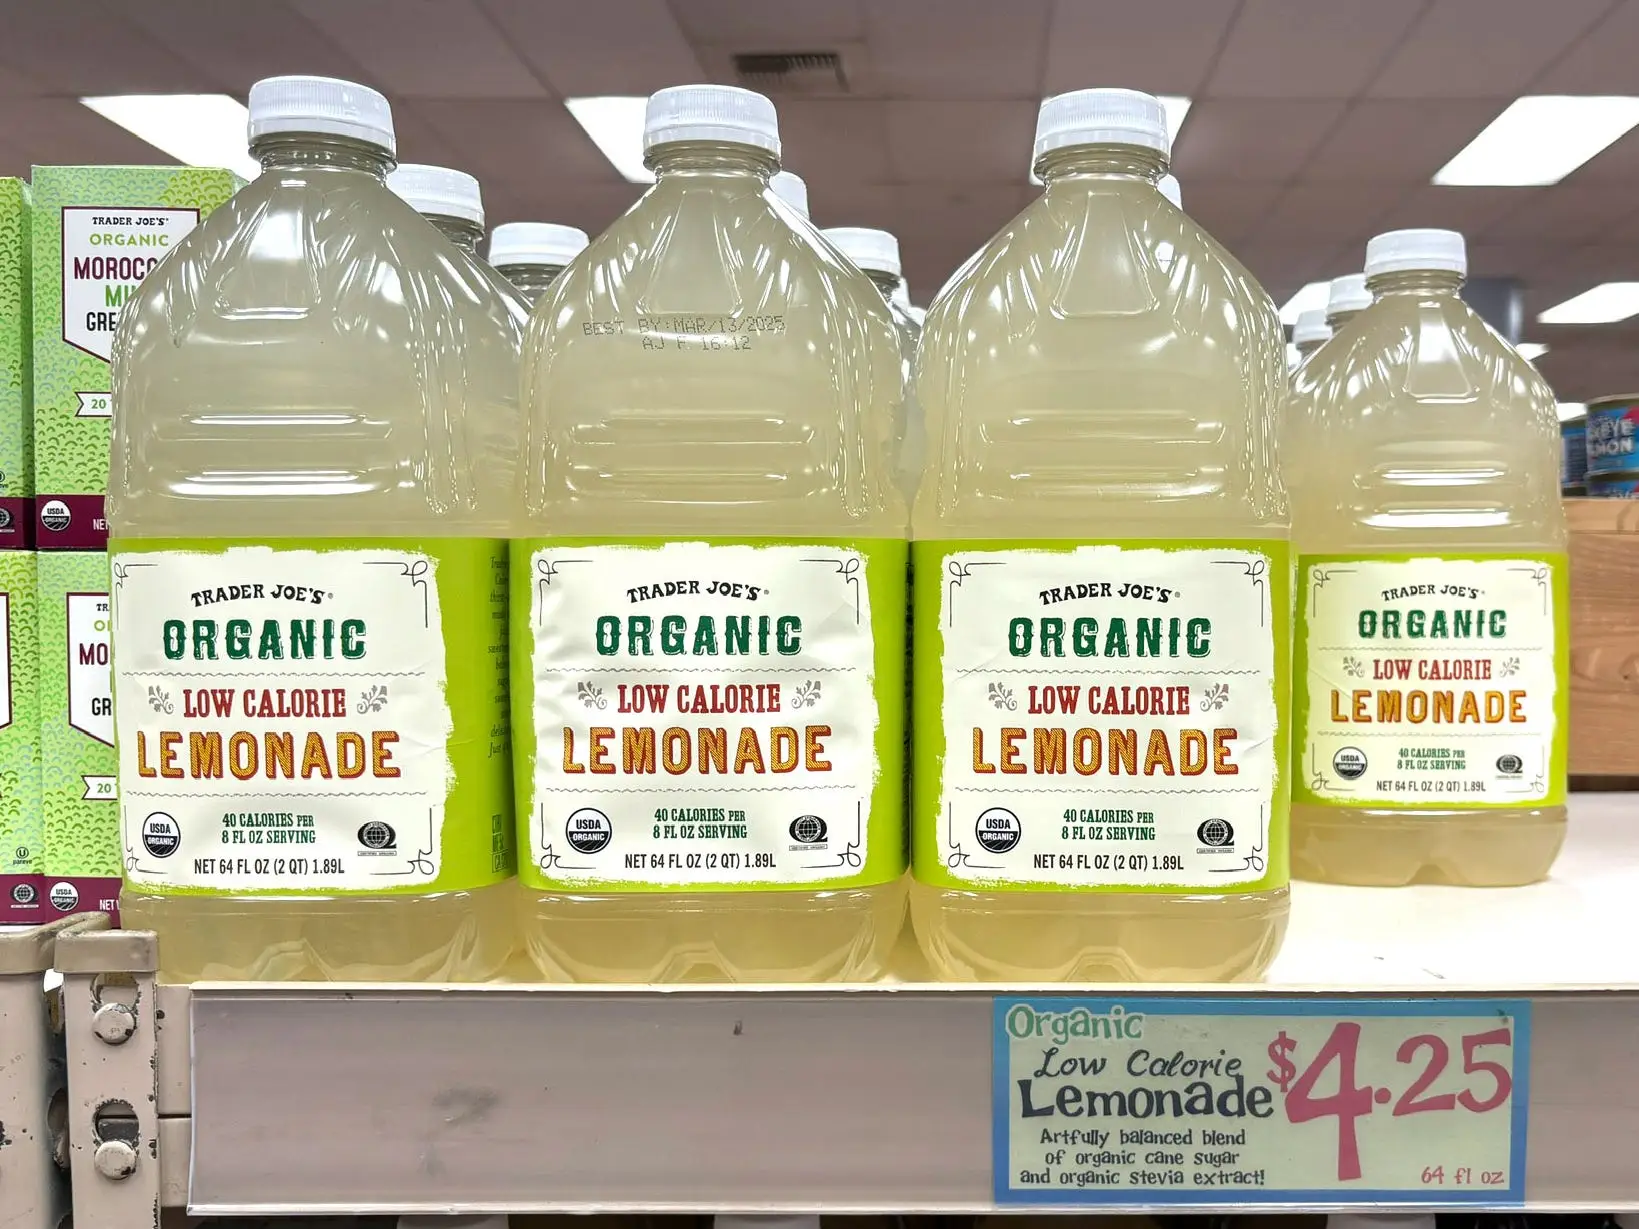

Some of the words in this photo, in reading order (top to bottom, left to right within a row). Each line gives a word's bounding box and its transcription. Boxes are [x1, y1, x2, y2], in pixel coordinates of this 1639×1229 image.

[92, 217, 132, 225] TRADER
[135, 217, 165, 226] JOE'S
[89, 233, 169, 246] ORGANIC
[105, 284, 137, 307] MI
[86, 311, 121, 331] GRE
[582, 321, 624, 336] BEST
[643, 336, 664, 350] AJ
[677, 336, 687, 349] F
[702, 336, 751, 350] 16:12
[91, 399, 106, 410] 20
[190, 584, 264, 607] TRADER
[270, 584, 326, 605] JOE'S
[626, 580, 700, 603] TRADER
[706, 580, 761, 601] JOE'S
[1039, 583, 1112, 605] TRADER
[1117, 583, 1172, 603] JOE'S
[1381, 584, 1435, 601] TRADER
[1440, 585, 1479, 600] JOE'S
[1357, 609, 1507, 638] ORGANIC
[162, 618, 368, 661] ORGANIC
[595, 615, 802, 656] ORGANIC
[1008, 616, 1212, 658] ORGANIC
[1373, 659, 1412, 680] LOW
[1418, 659, 1492, 680] CALORIE
[182, 688, 235, 718] LOW
[243, 688, 346, 718] CALORIE
[617, 684, 669, 713] LOW
[677, 684, 781, 713] CALORIE
[1028, 686, 1081, 715] LOW
[1088, 686, 1190, 715] CALORIE
[1330, 689, 1527, 724] LEMONADE
[136, 730, 401, 781] LEMONADE
[562, 725, 832, 775] LEMONADE
[972, 727, 1239, 776] LEMONADE
[1398, 749, 1409, 758] 40
[1410, 749, 1450, 758] CALORIES
[1452, 750, 1465, 758] PER
[1397, 760, 1403, 770] 8
[1404, 760, 1415, 770] FL
[1417, 760, 1427, 770] OZ
[1429, 760, 1466, 770] SERVING
[97, 783, 111, 793] 20
[1376, 780, 1392, 791] NET
[1395, 780, 1406, 791] 64
[1408, 780, 1419, 791] FL
[1421, 780, 1432, 791] OZ
[1463, 780, 1486, 792] 1.89L
[222, 813, 237, 828] 40
[239, 813, 293, 828] CALORIES
[296, 815, 315, 827] PER
[654, 808, 669, 822] 40
[670, 808, 725, 822] CALORIES
[728, 810, 746, 821] PER
[1063, 810, 1077, 823] 40
[1079, 810, 1134, 823] CALORIES
[1136, 811, 1154, 823] PER
[149, 822, 171, 834] USDA
[575, 819, 601, 830] USDA
[652, 824, 660, 839] 8
[663, 824, 678, 839] FL
[680, 824, 695, 839] OZ
[698, 824, 747, 839] SERVING
[985, 819, 1011, 829] USDA
[147, 836, 174, 846] ORGANIC
[221, 829, 229, 844] 8
[232, 829, 246, 844] FL
[248, 829, 263, 844] OZ
[266, 829, 316, 844] SERVING
[572, 832, 605, 842] ORGANIC
[982, 831, 1014, 841] ORGANIC
[1061, 826, 1069, 840] 8
[1072, 826, 1086, 840] FL
[1088, 826, 1103, 840] OZ
[1106, 826, 1156, 841] SERVING
[194, 858, 216, 875] NET
[219, 858, 234, 875] 64
[237, 858, 251, 875] FL
[254, 858, 270, 875] OZ
[274, 858, 285, 875] (2
[287, 858, 309, 875] QT)
[312, 858, 345, 875] 1.89L
[625, 854, 647, 869] NET
[650, 854, 665, 869] 64
[669, 854, 683, 869] FL
[686, 854, 701, 869] OZ
[705, 854, 717, 870] (2
[720, 854, 740, 870] QT)
[744, 854, 776, 868] 1.89L
[1033, 854, 1056, 870] NET
[1059, 854, 1074, 870] 64
[1077, 854, 1091, 870] FL
[1095, 854, 1109, 870] OZ
[1113, 854, 1125, 871] (2
[1128, 854, 1148, 871] QT)
[1152, 855, 1184, 870] 1.89L
[100, 899, 114, 910] NET
[1008, 1006, 1143, 1045] Organic
[1033, 1046, 1107, 1078] Low
[1126, 1049, 1242, 1078] Calorie
[1017, 1072, 1274, 1119] Lemonade
[1266, 1022, 1512, 1182] $4.25
[1040, 1128, 1109, 1149] Artfully
[1120, 1128, 1193, 1145] balanced
[1202, 1128, 1246, 1145] blend
[1045, 1149, 1066, 1165] of
[1075, 1150, 1135, 1167] organic
[1144, 1150, 1184, 1165] cane
[1193, 1151, 1240, 1167] sugar
[1020, 1168, 1050, 1184] and
[1059, 1170, 1120, 1187] organic
[1129, 1169, 1184, 1185] stevia
[1193, 1169, 1264, 1185] extract!
[1421, 1165, 1444, 1184] 64
[1454, 1167, 1471, 1184] fl
[1481, 1171, 1504, 1184] oz
